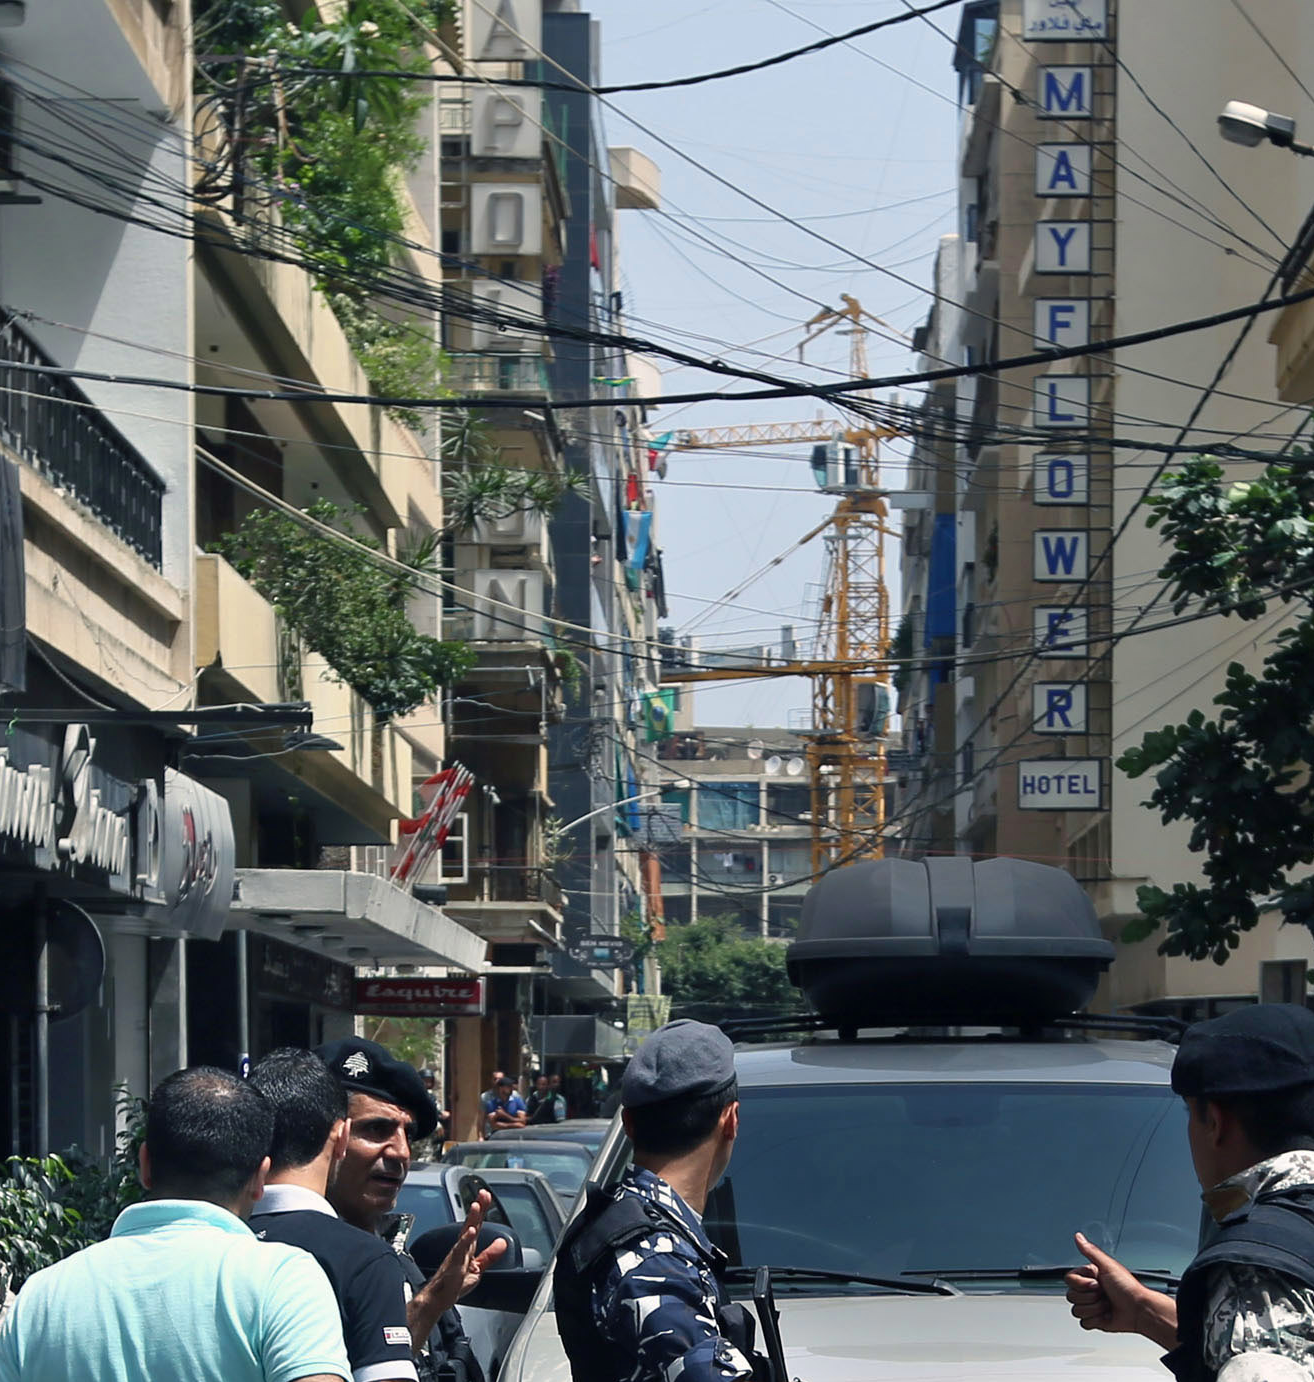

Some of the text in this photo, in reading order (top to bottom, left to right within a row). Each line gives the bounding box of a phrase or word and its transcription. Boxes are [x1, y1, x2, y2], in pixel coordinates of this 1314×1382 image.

[1041, 71, 1085, 728] MAYFLOWER
[1021, 774, 1096, 795] HOTEL
[365, 984, 474, 1001] Esquire
